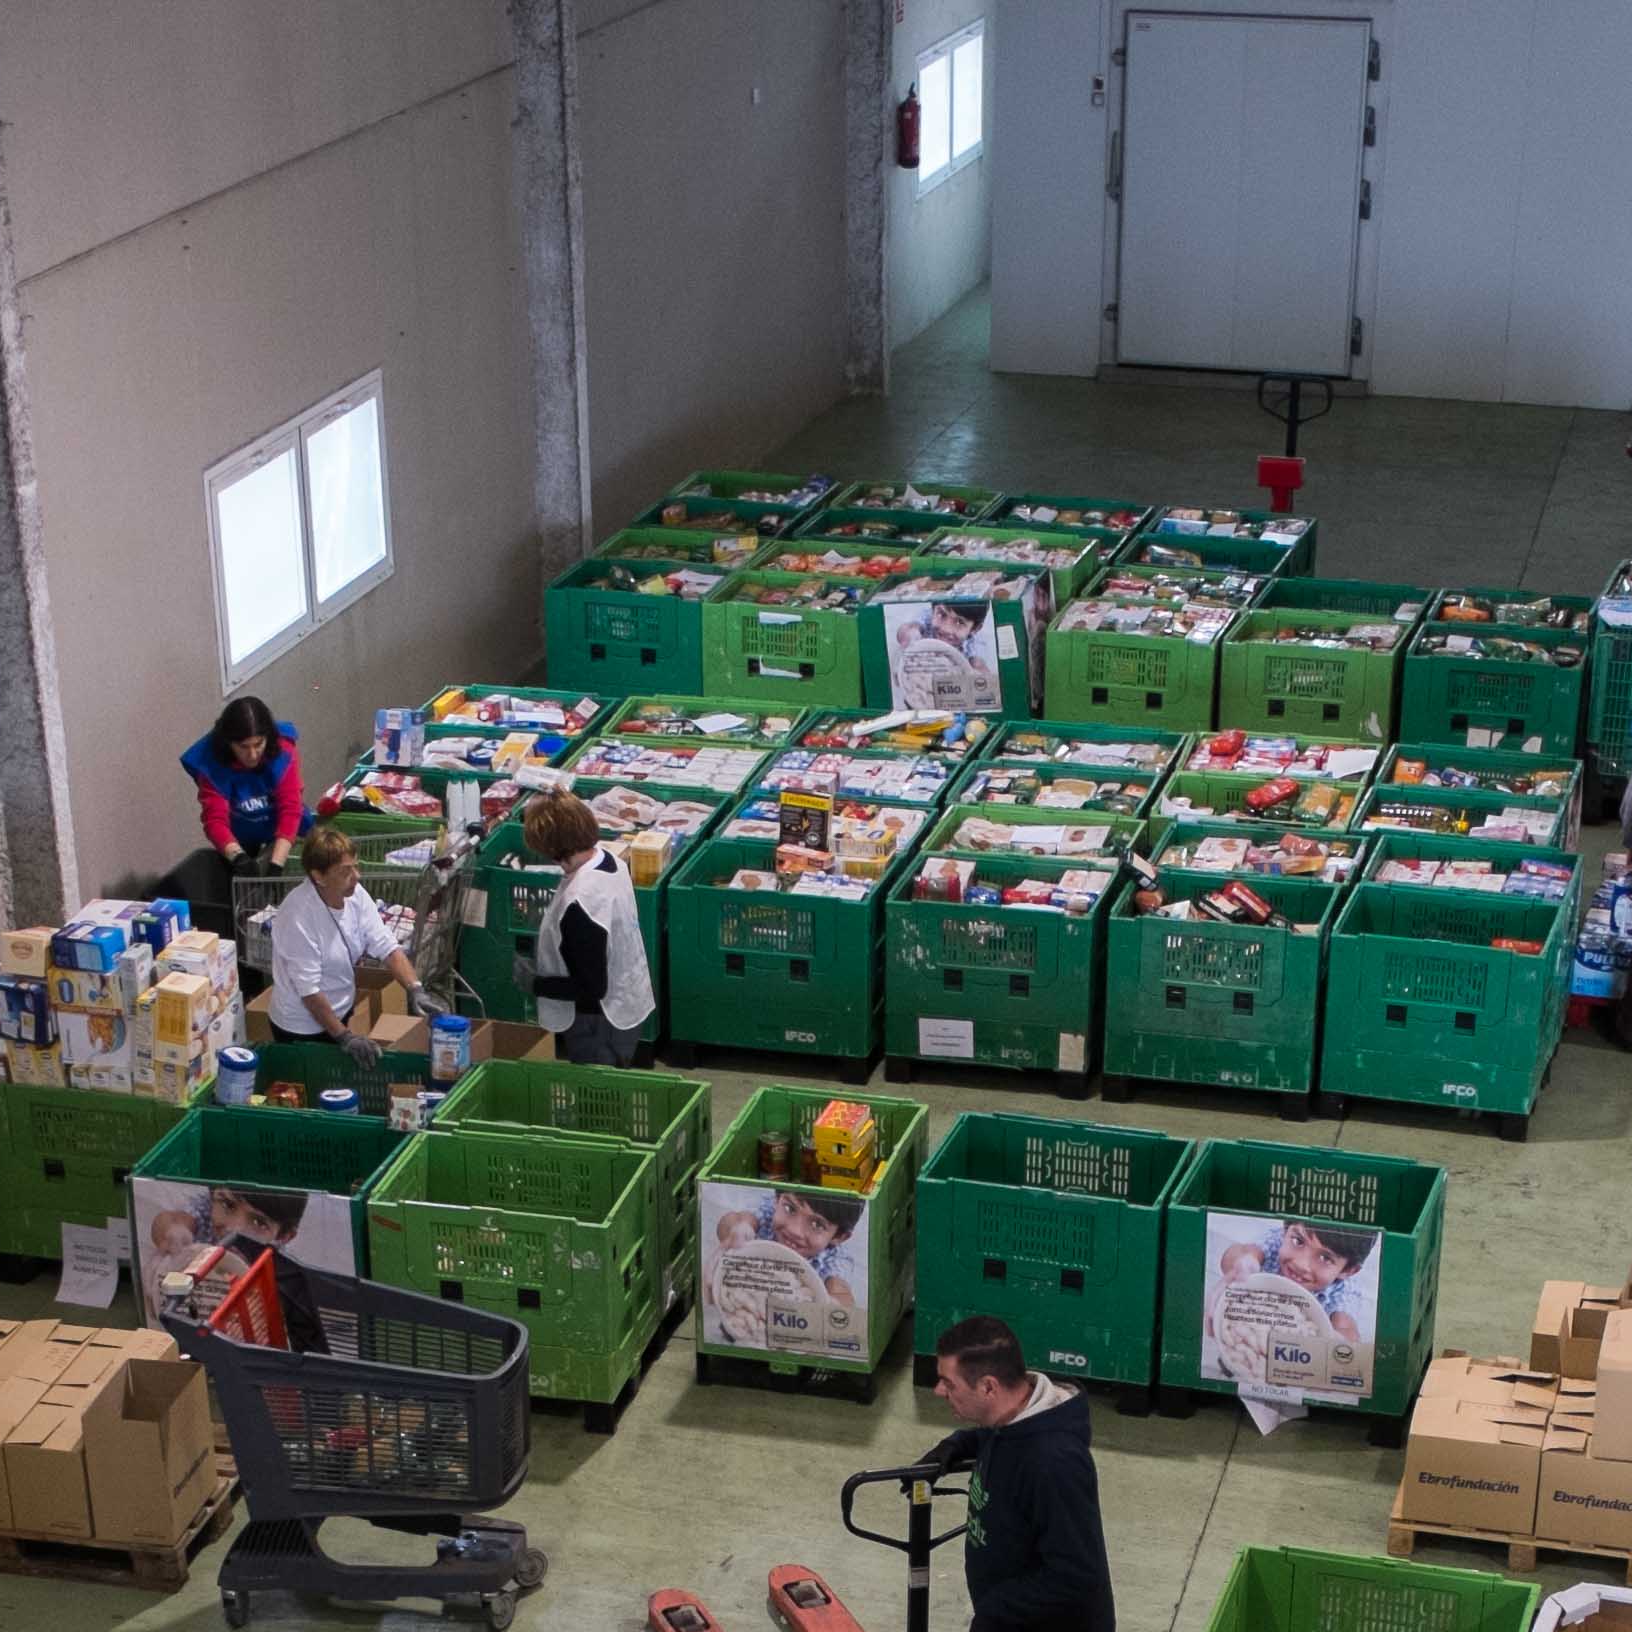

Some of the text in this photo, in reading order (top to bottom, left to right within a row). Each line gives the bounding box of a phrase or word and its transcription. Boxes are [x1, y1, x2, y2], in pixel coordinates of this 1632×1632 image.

[785, 1030, 816, 1042] IFCO
[1443, 1084, 1476, 1097] IFCO
[773, 1312, 808, 1330] Kilo
[1049, 1351, 1087, 1367] IFCO
[1274, 1346, 1311, 1364] Kilo
[1418, 1471, 1518, 1495] Ebrofundación
